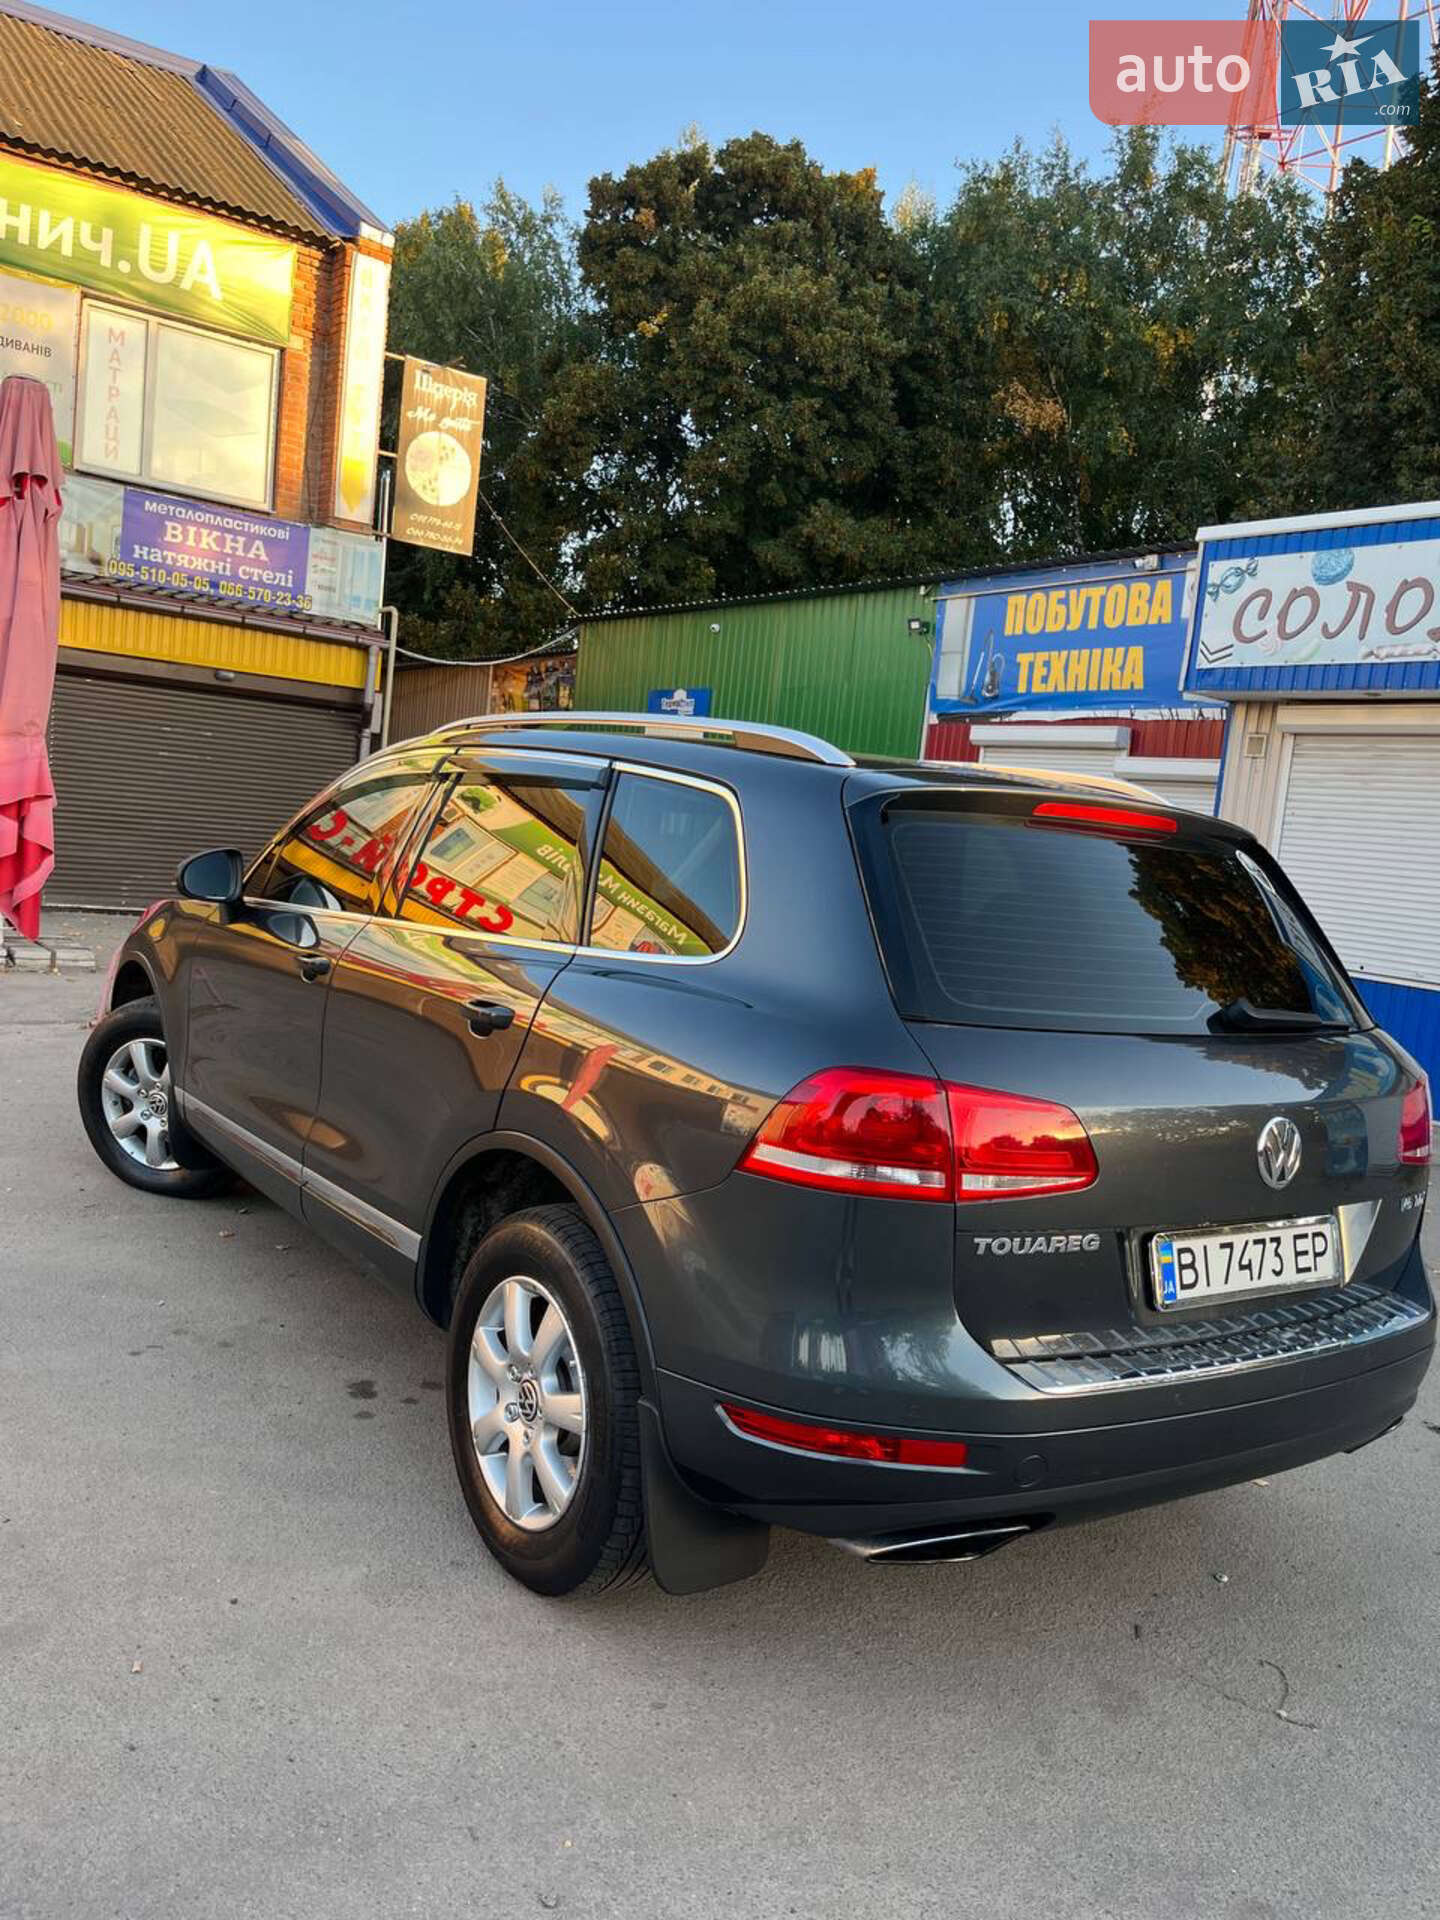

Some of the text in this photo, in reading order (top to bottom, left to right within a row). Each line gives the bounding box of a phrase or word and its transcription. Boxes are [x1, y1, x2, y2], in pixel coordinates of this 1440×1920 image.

[104, 327, 125, 460] МАТРАЦИ
[164, 521, 269, 561] ВІКНА
[133, 545, 231, 577] натяжні
[238, 564, 293, 588] стелі
[1004, 579, 1173, 636] ПОБУТОВА
[1016, 646, 1144, 694] ТЕХНІКА
[973, 1233, 1100, 1256] TOUAREG
[1177, 1231, 1328, 1291] BI 7473 EP
